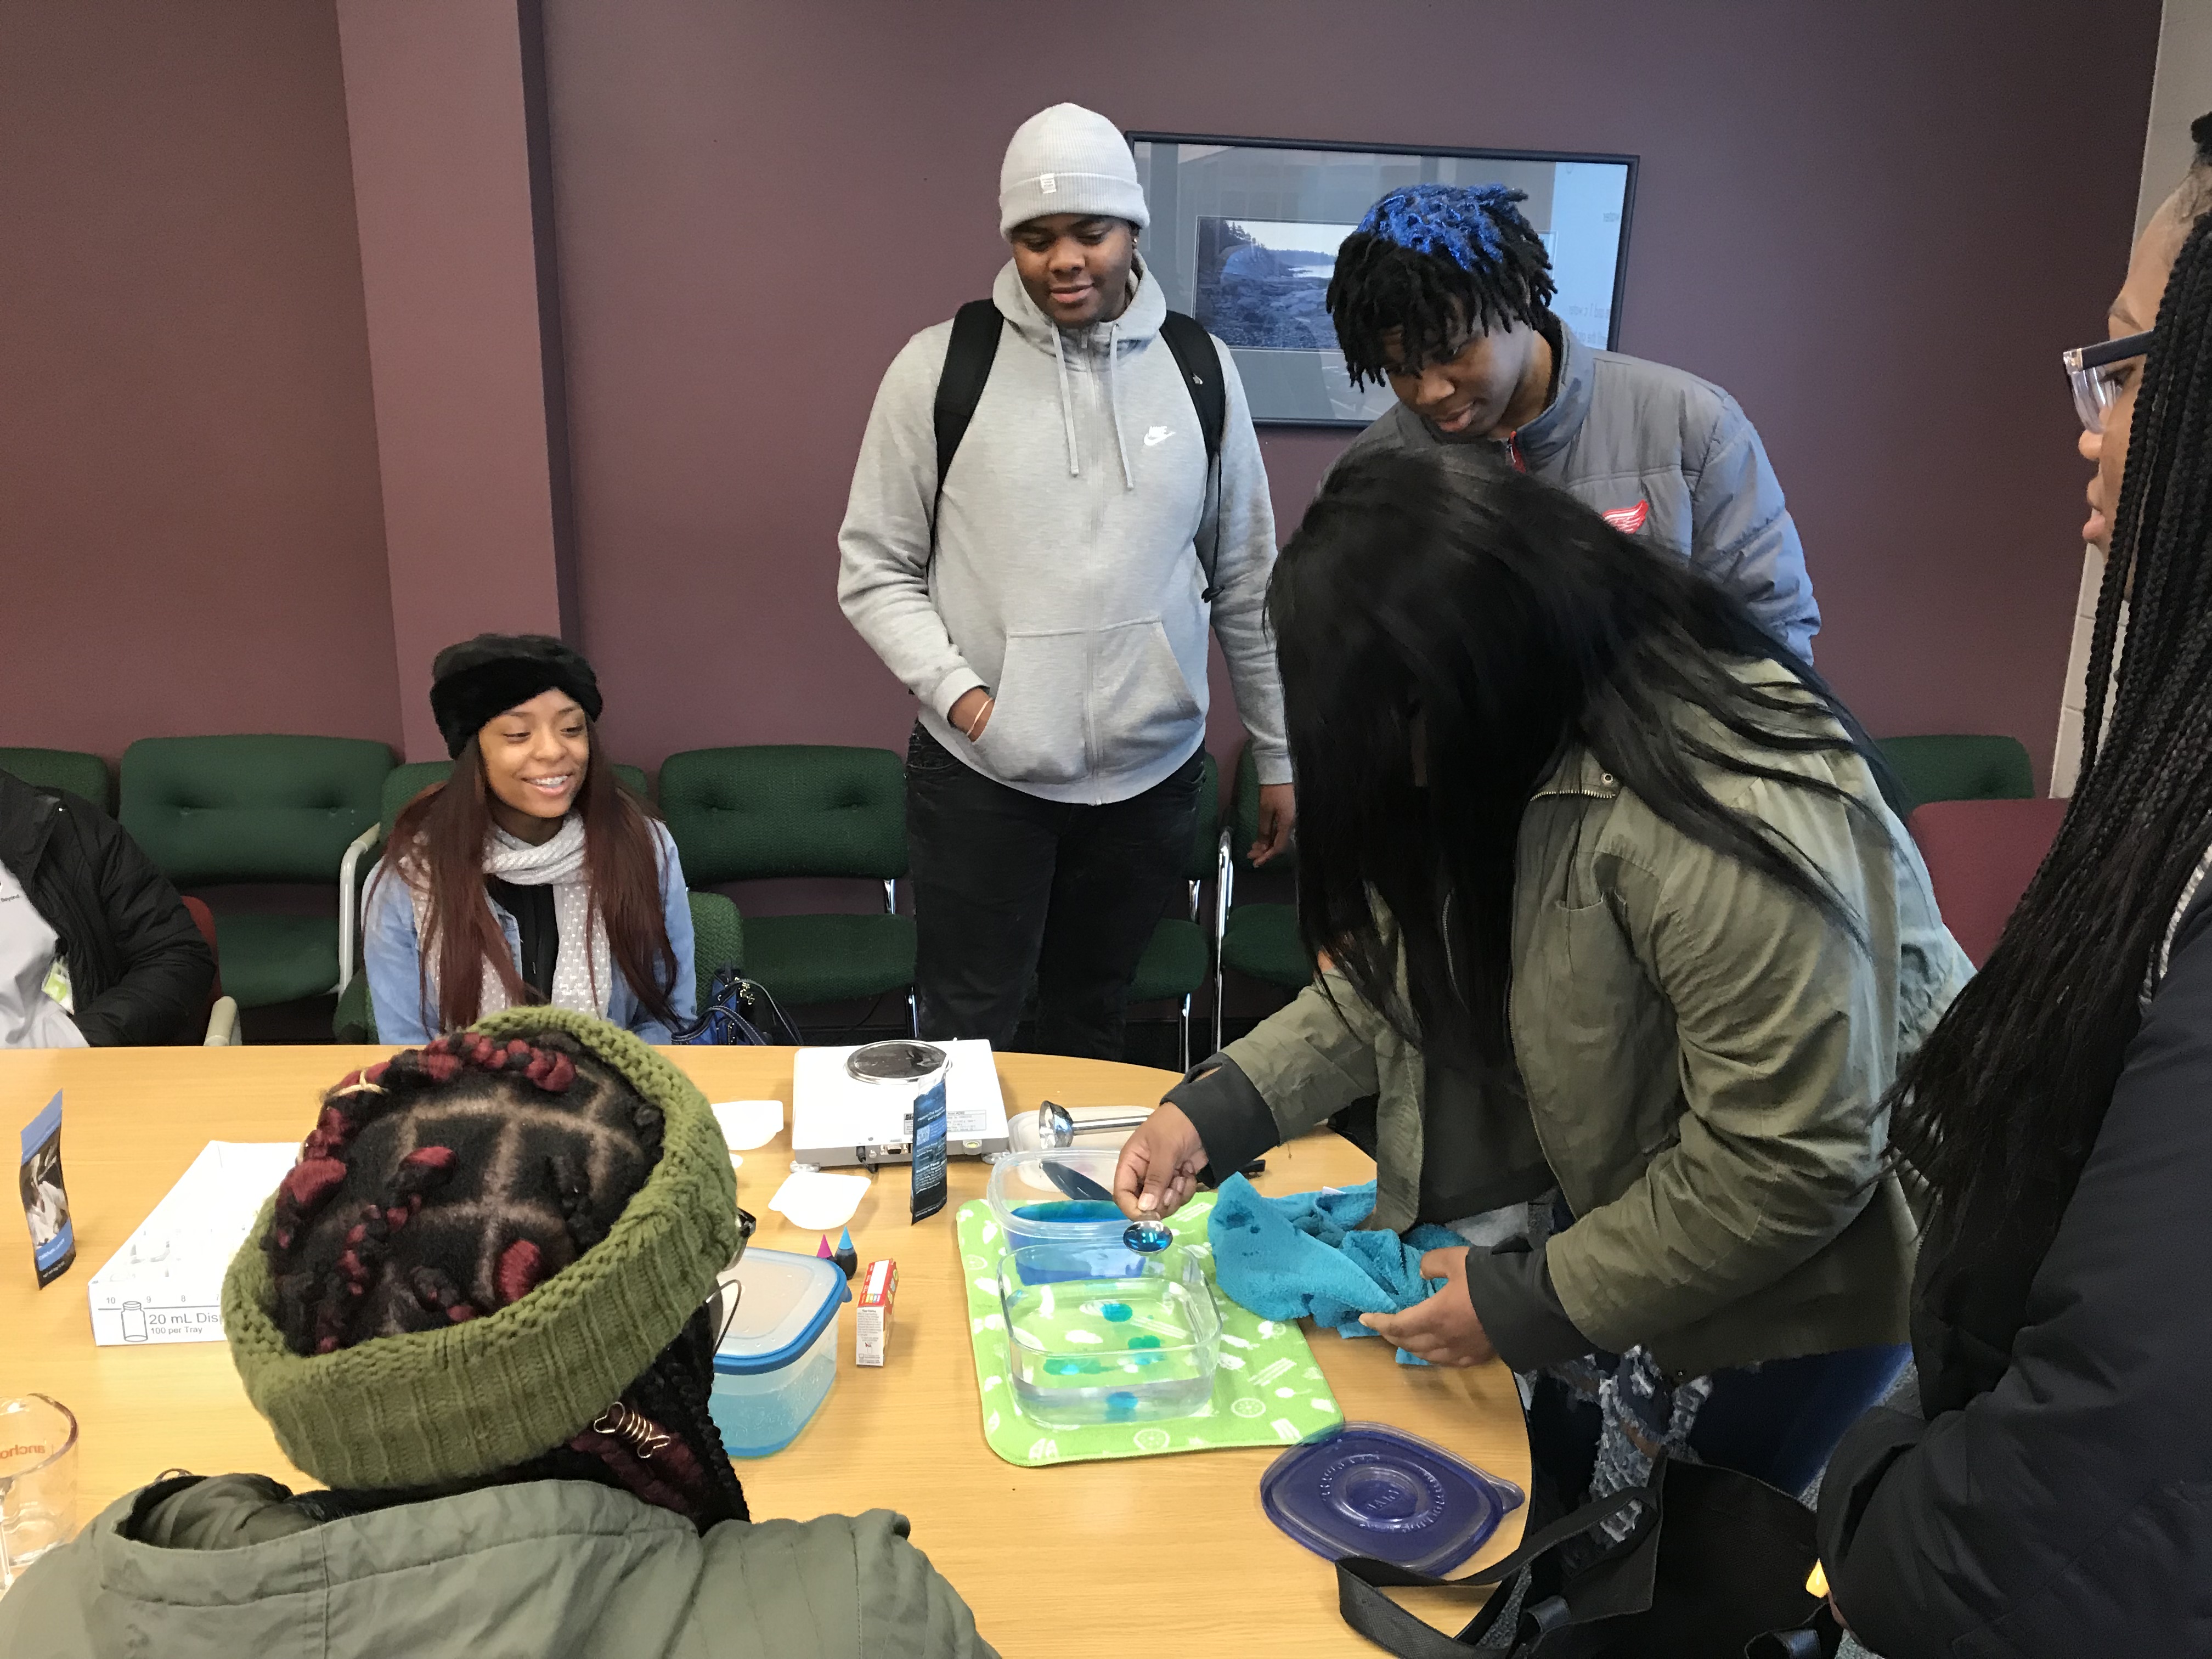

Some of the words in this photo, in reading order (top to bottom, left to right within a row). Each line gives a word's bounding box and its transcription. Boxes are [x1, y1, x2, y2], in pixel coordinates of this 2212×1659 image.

[149, 1314, 166, 1325] 20
[171, 1313, 192, 1324] mL
[184, 1326, 202, 1334] Tray
